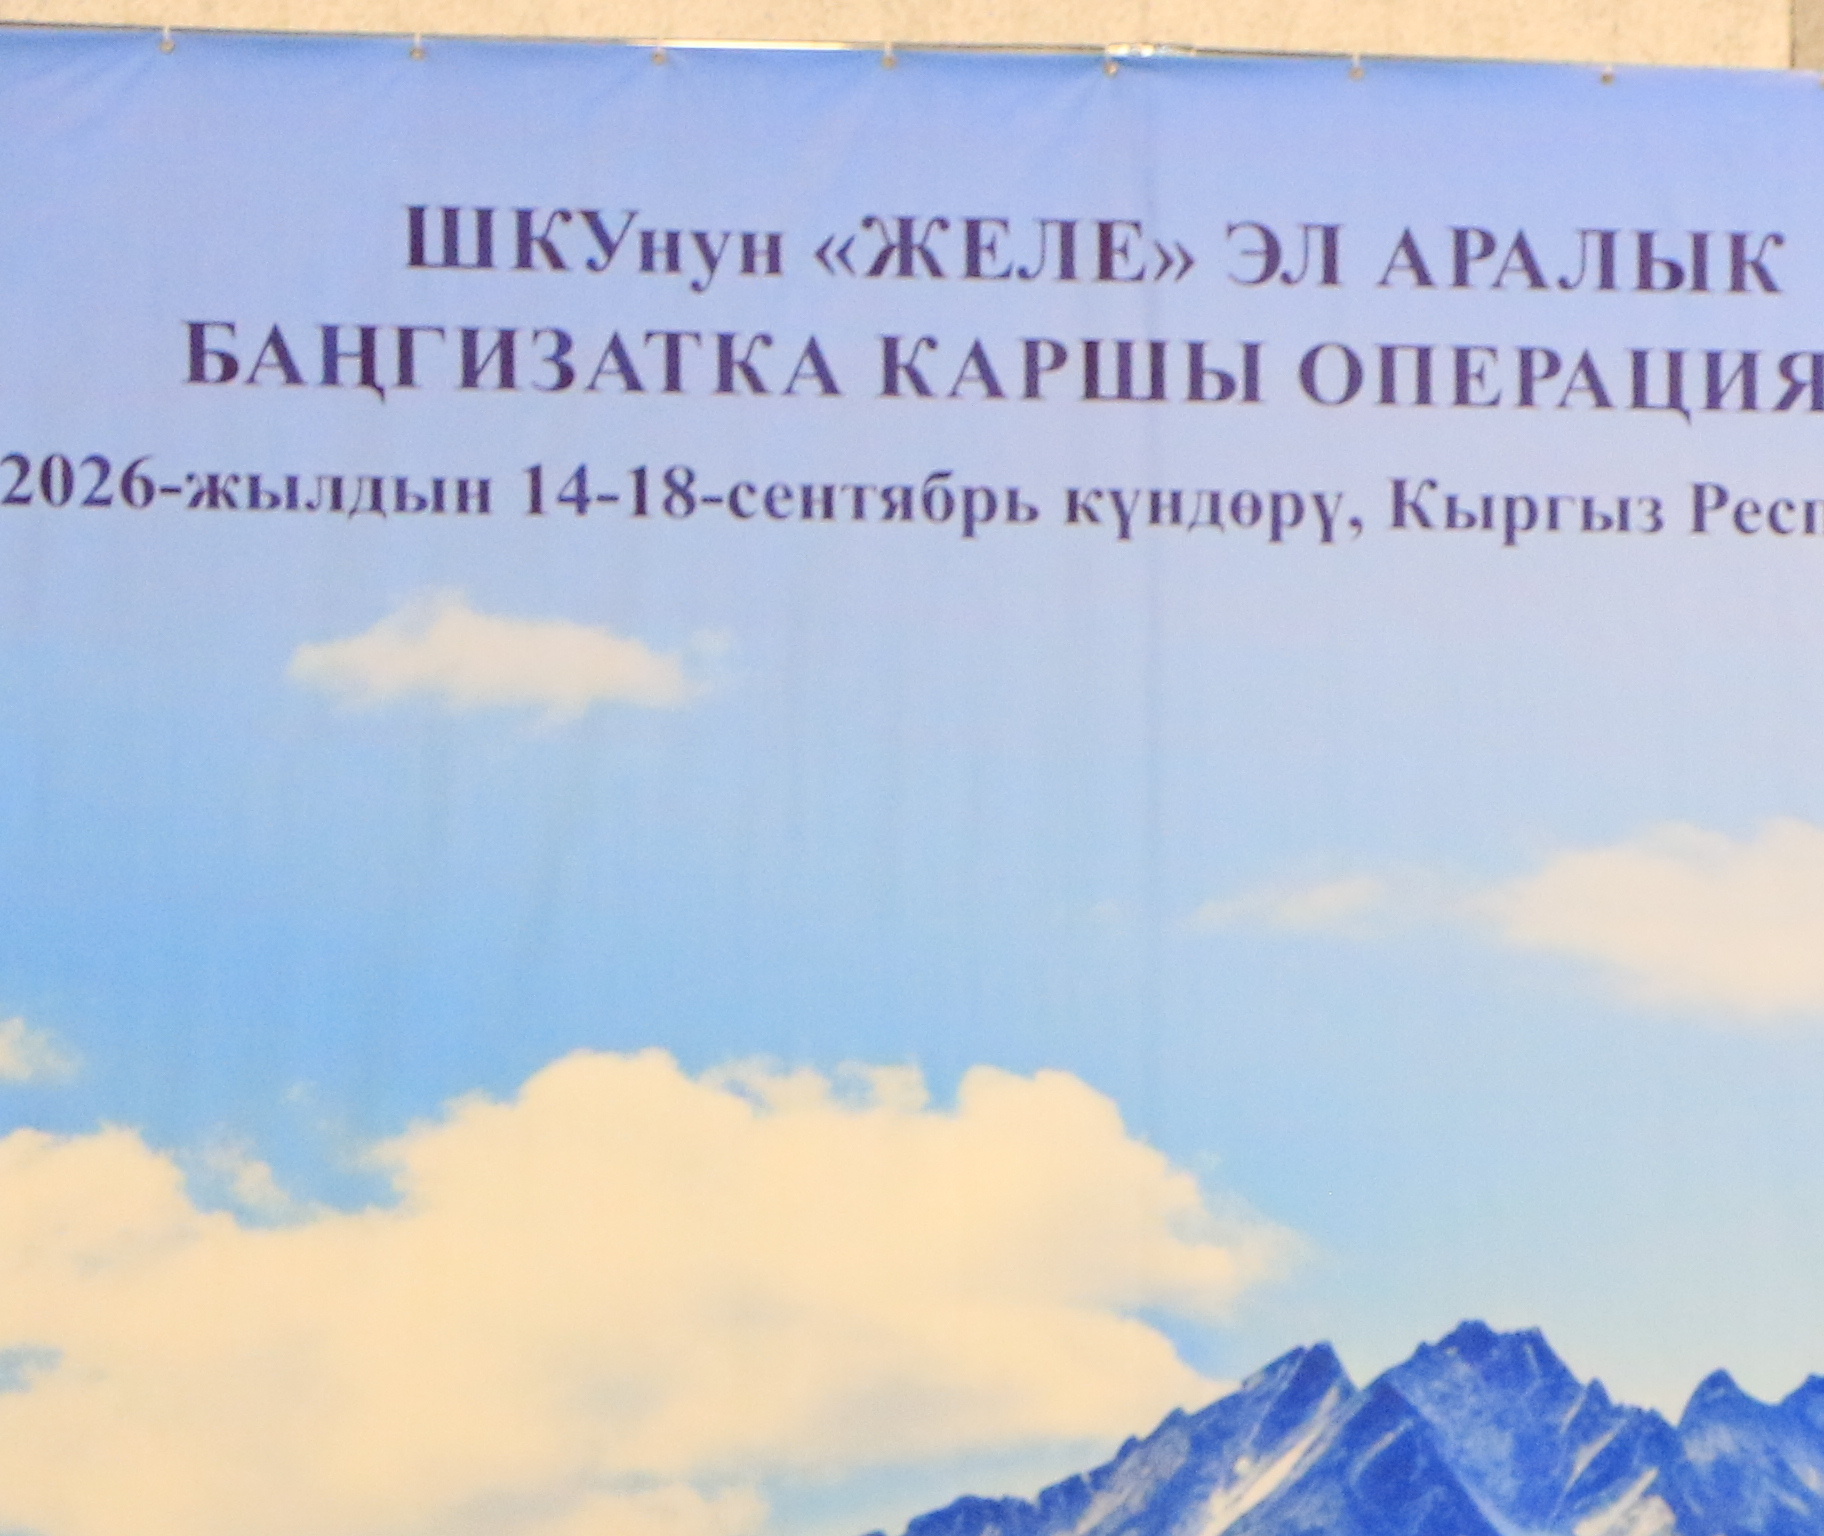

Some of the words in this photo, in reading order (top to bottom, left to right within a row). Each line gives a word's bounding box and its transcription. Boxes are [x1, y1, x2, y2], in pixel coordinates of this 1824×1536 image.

[407, 204, 781, 293] ШКУнун
[815, 214, 1194, 284] «ЖЕЛЕ»
[1227, 224, 1340, 285] ЭЛ
[1378, 227, 1784, 294] АРАЛЫК
[184, 320, 840, 404] БАҢГИЗАТКА
[881, 335, 1261, 405] КАРШЫ
[0, 451, 491, 519] 2026-жылдын
[525, 463, 1040, 539] 14-18-сентябрь
[1065, 485, 1363, 546] күндөрү,
[1389, 478, 1664, 549] Кыргыз
